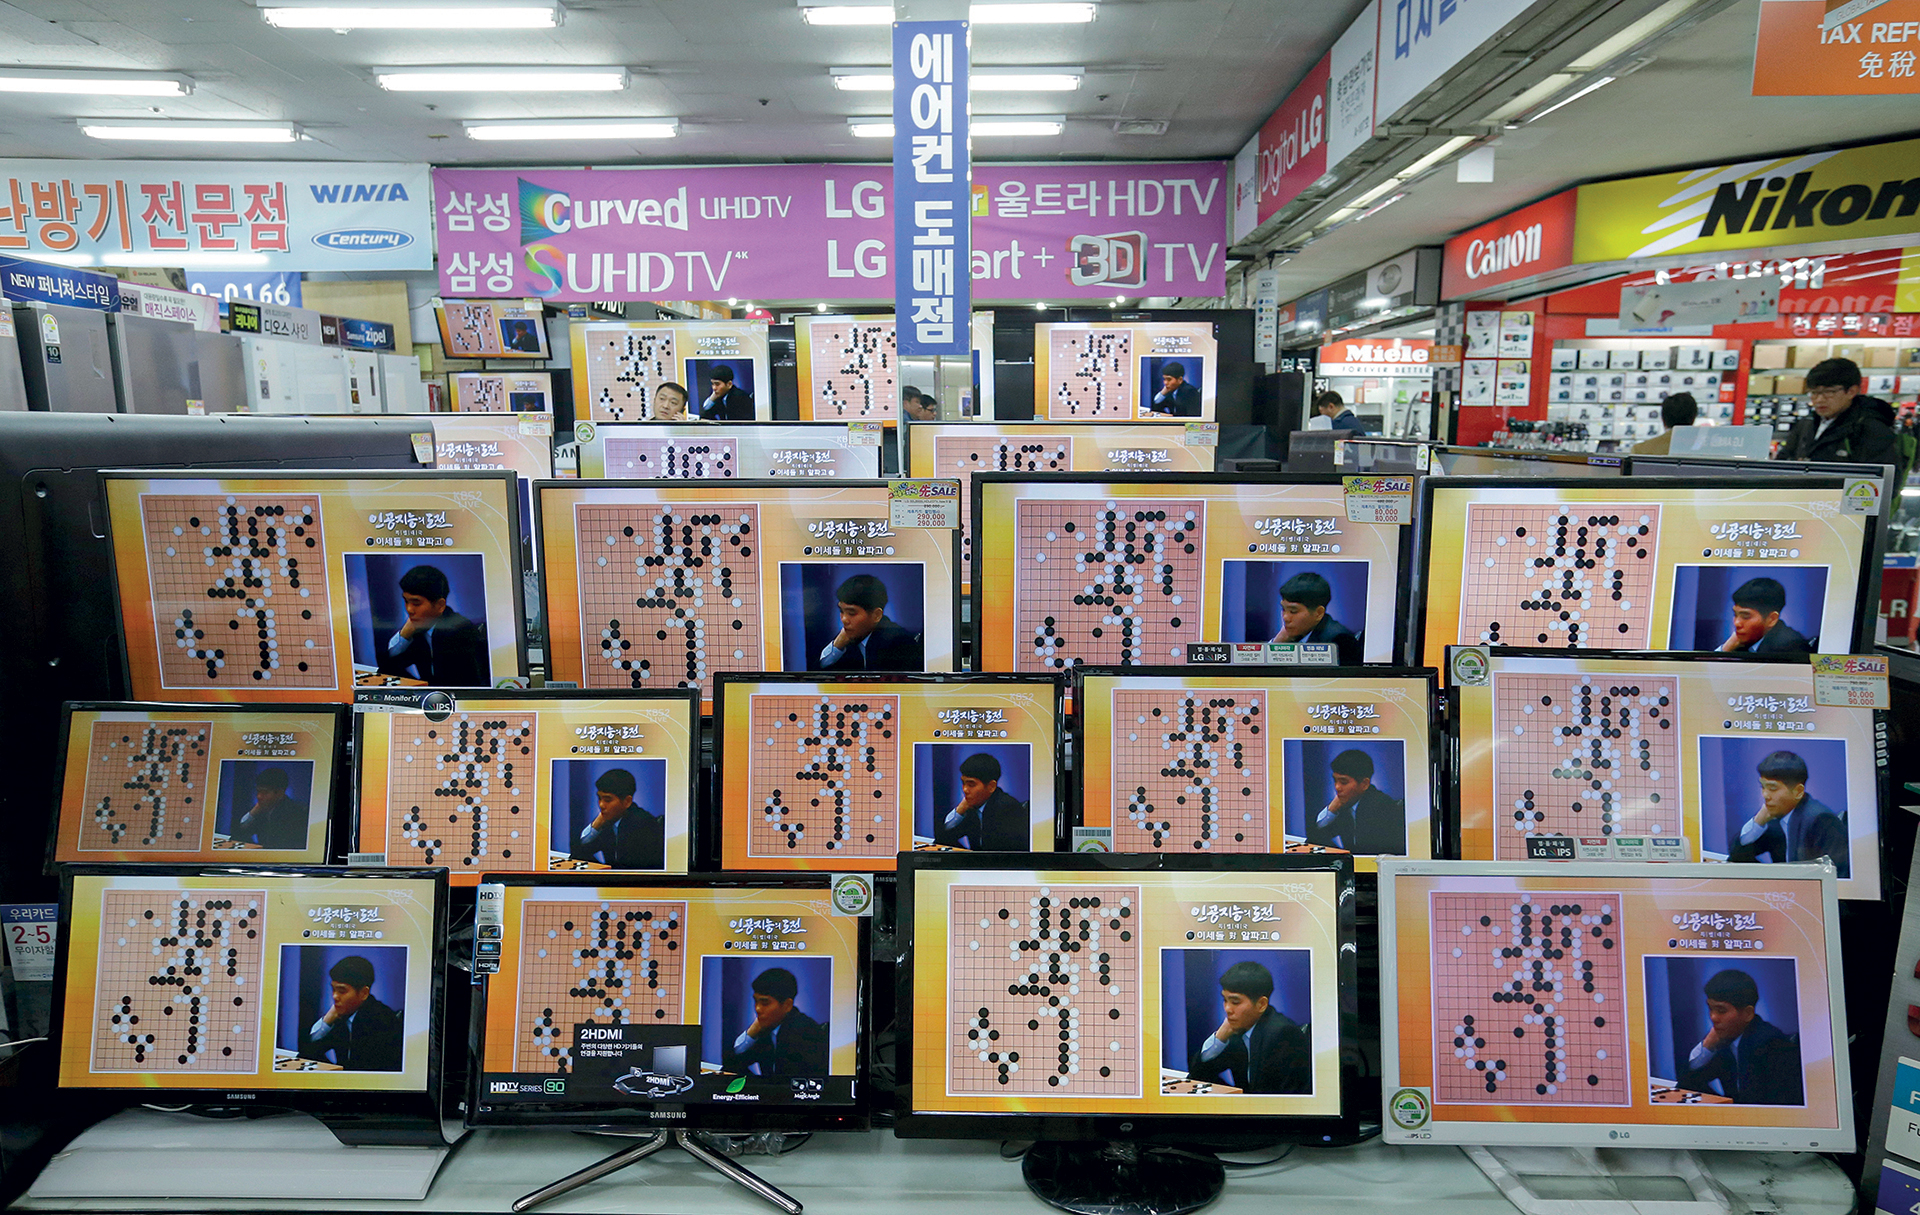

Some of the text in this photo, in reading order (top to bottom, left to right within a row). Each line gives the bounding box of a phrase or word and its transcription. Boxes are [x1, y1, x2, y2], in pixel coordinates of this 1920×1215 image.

[1817, 21, 1920, 44] TAX REF
[1261, 117, 1298, 196] Digital
[1300, 94, 1323, 158] LG
[310, 183, 409, 203] WINIA
[910, 32, 954, 344] 에어컨 도매점
[825, 179, 886, 219] LG
[1699, 171, 1920, 238] Nikon
[141, 180, 289, 251] 전문점
[443, 186, 792, 233] 삼성 Curved UHDTV
[328, 232, 400, 250] Century
[827, 240, 887, 279] LG
[971, 240, 1025, 281] art
[1064, 231, 1148, 288] 3D
[1154, 243, 1218, 282] TV
[1465, 222, 1542, 280] Canon
[446, 251, 514, 293] 삼성
[735, 250, 749, 260] 4K
[10, 272, 110, 306] NEW 퍼니처스타일
[144, 302, 197, 322] 매직스페이스
[322, 324, 337, 336] NEW
[365, 328, 387, 345] zipel
[48, 346, 59, 357] 10
[1345, 345, 1429, 362] Miele
[1192, 653, 1227, 661] LG IPS
[384, 694, 411, 702] Monitor
[435, 703, 450, 711] IPS
[1533, 849, 1571, 857] LG IPS
[10, 908, 55, 920] 우리카드
[1197, 932, 1225, 941] 이세돌
[1241, 931, 1270, 941] 알파고
[1679, 939, 1707, 949] 이세돌
[1724, 940, 1753, 949] 알파고
[580, 1028, 623, 1040] 2HDMI
[489, 1082, 519, 1092] HDTV
[546, 1081, 565, 1092] 90
[646, 1076, 670, 1087] 2HDMI
[712, 1093, 759, 1101] Energy-Efficient
[650, 1111, 687, 1119] SAMSUNG
[1619, 1131, 1630, 1139] LG
